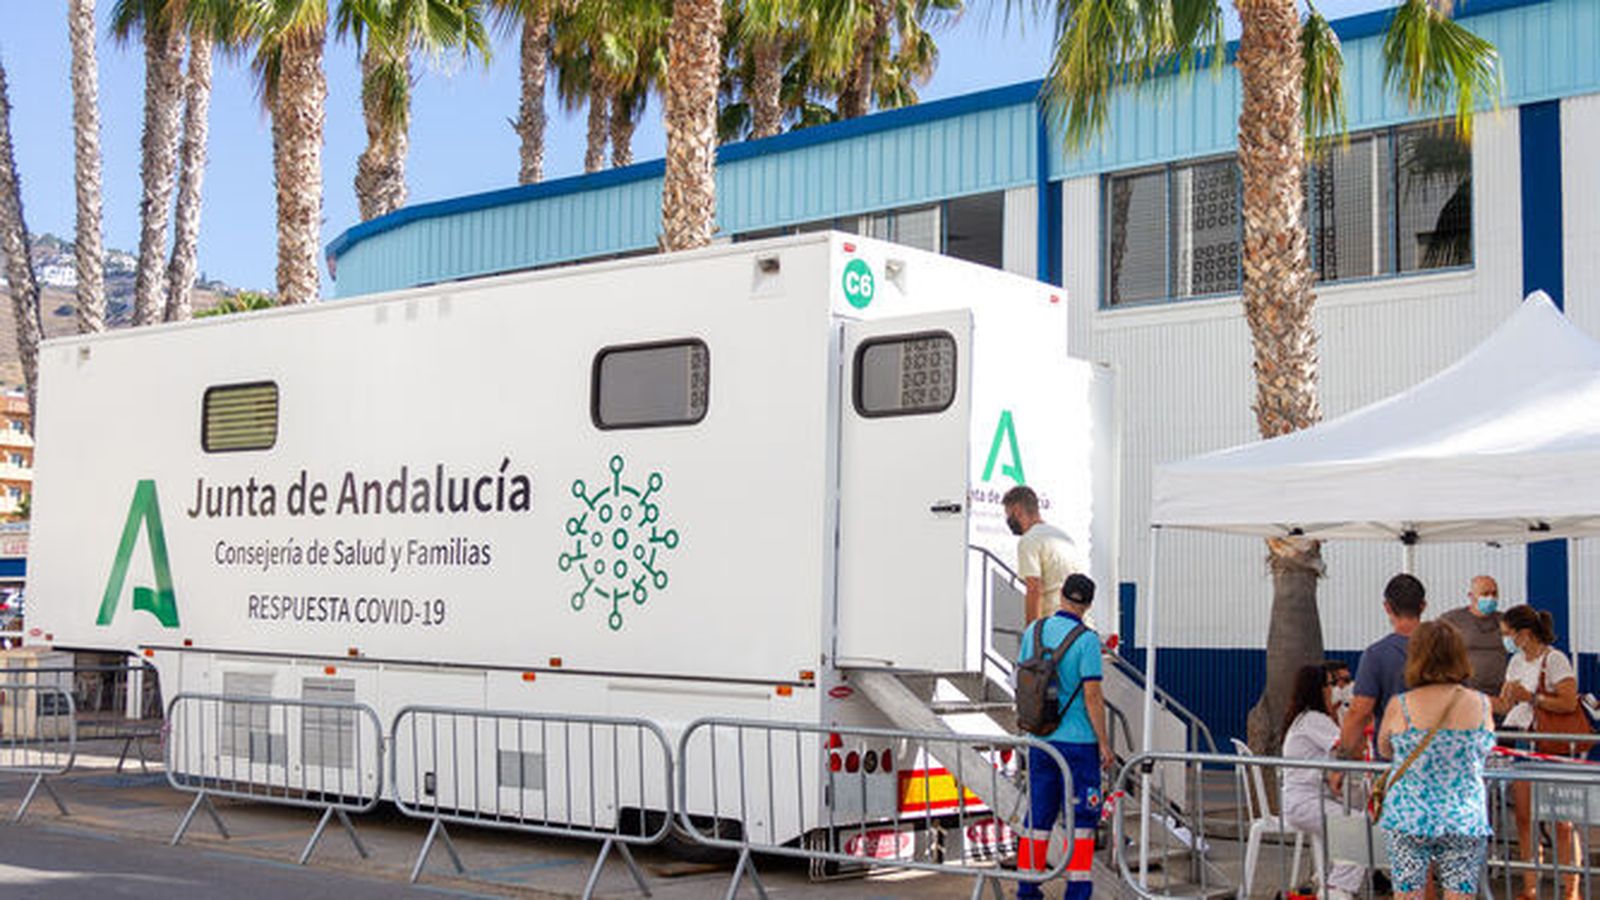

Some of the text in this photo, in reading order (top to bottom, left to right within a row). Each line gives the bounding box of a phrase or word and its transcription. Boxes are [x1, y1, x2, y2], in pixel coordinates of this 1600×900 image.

[846, 271, 872, 297] C6
[188, 456, 531, 518] Junta de Andalucía
[214, 537, 491, 573] Consejería de Salud y Familias
[248, 595, 446, 626] RESPUESTA COVID-19
